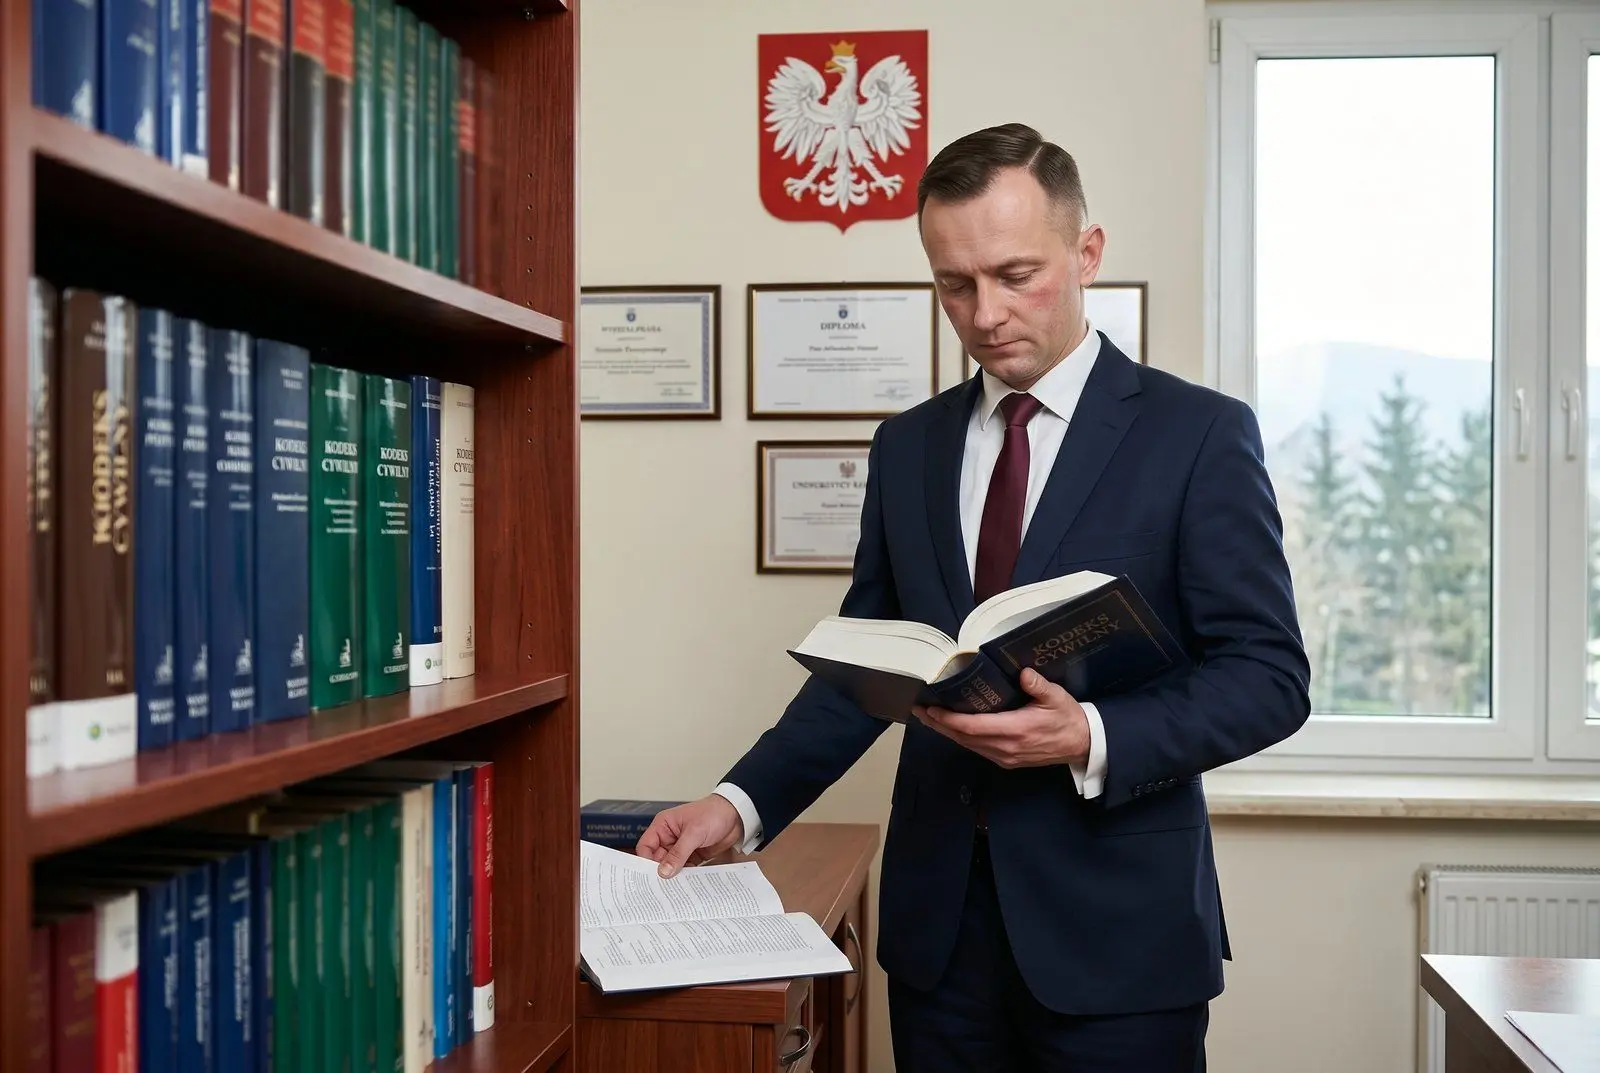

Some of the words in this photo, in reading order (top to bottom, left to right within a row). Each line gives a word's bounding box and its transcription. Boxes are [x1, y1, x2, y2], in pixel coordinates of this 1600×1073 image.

[820, 322, 867, 331] DIPLOMA
[324, 440, 358, 456] KODEKS
[380, 447, 409, 462] KODEKS
[1032, 613, 1109, 656] KODEKS
[1034, 620, 1120, 666] CYWILNY
